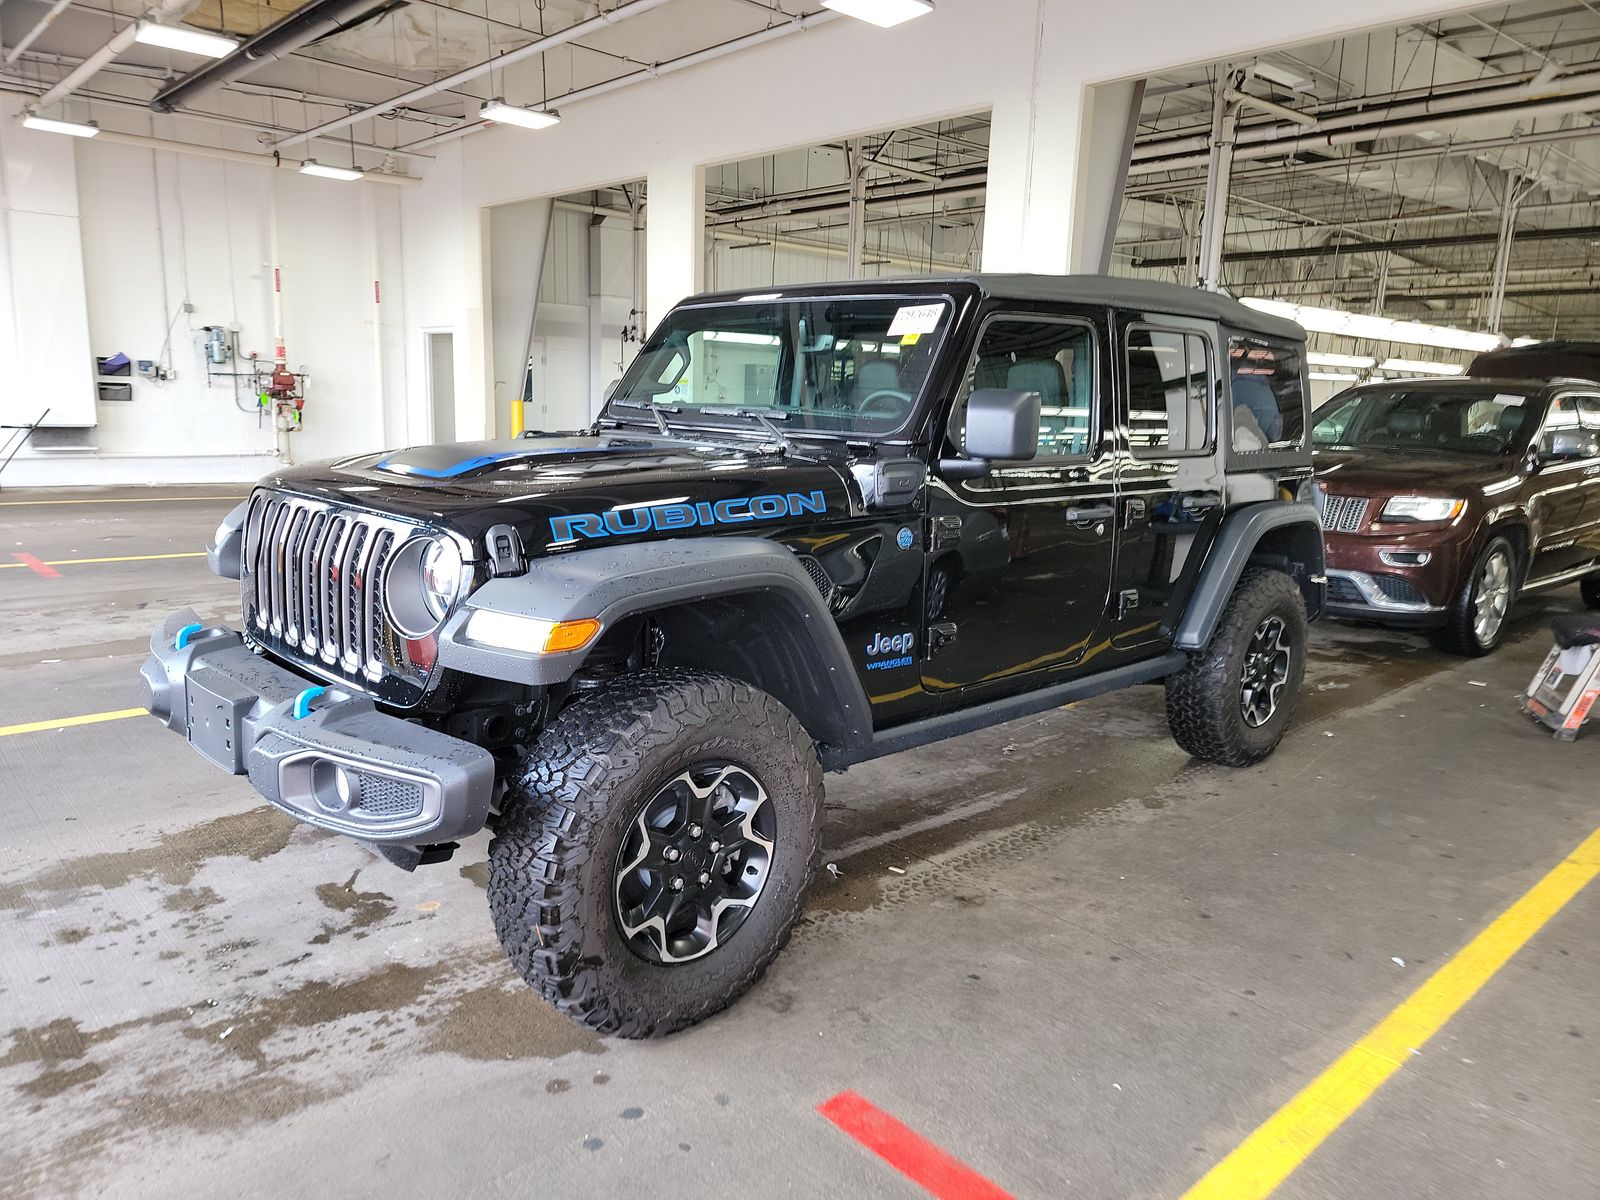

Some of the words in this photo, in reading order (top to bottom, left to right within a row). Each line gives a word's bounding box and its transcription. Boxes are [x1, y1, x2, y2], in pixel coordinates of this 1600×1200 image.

[549, 490, 827, 543] RUBICON
[866, 632, 914, 656] Jeep
[866, 656, 913, 670] WRANGLER
